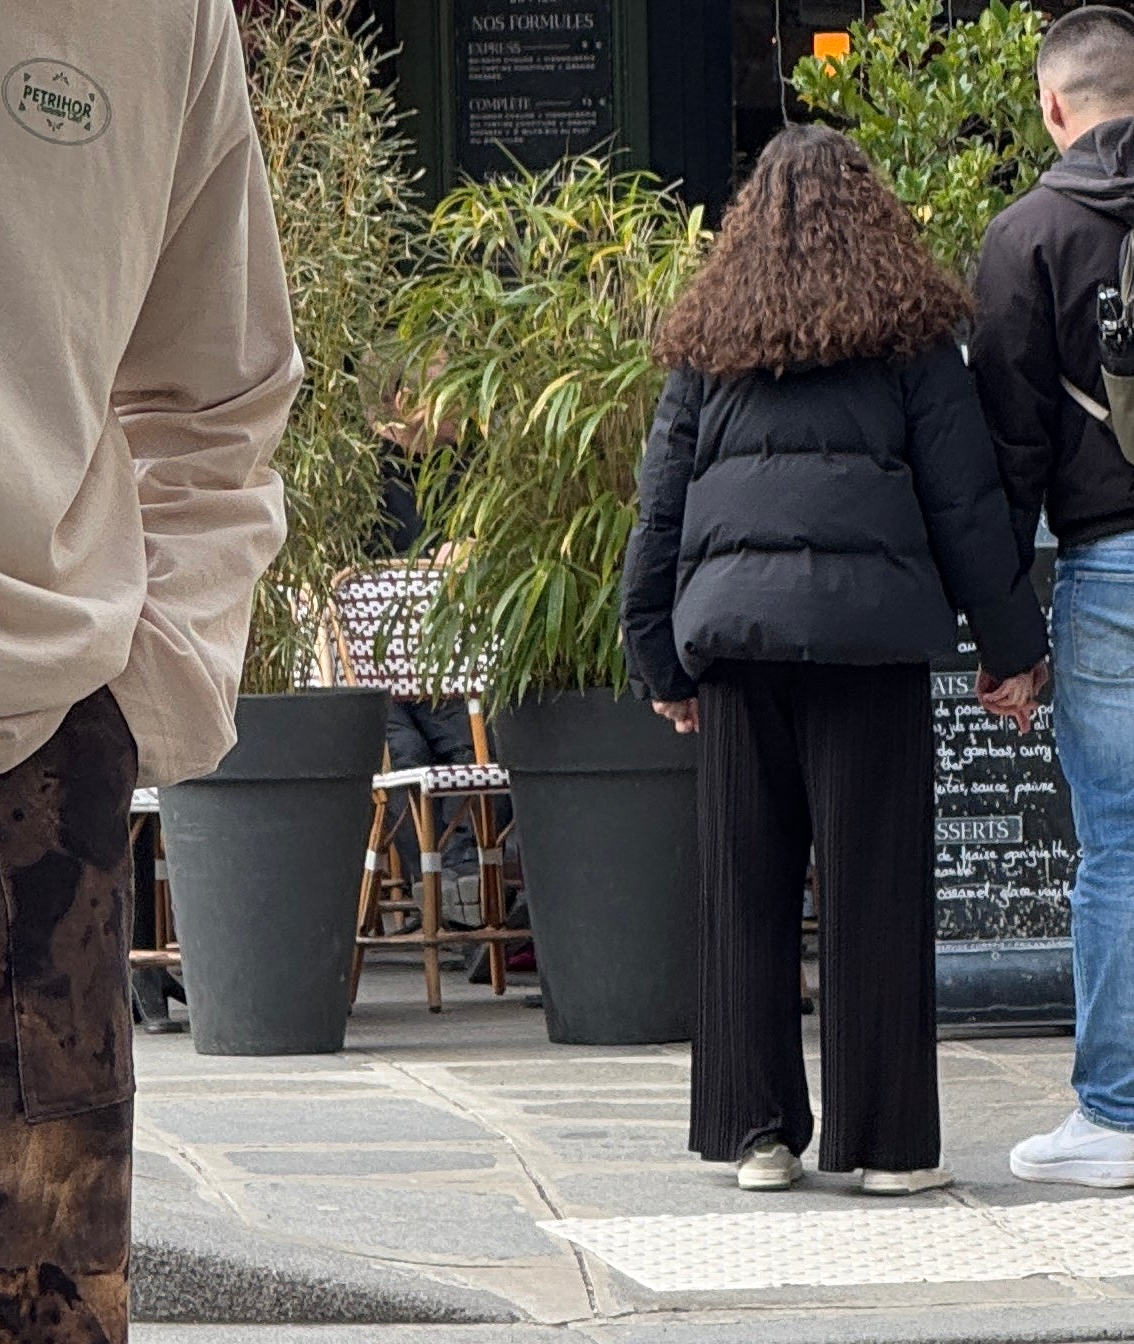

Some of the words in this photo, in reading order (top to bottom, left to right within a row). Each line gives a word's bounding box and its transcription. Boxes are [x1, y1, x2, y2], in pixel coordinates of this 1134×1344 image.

[472, 14, 505, 32] NOS
[509, 13, 594, 31] FORMULES
[23, 84, 92, 119] PETRIHOR
[932, 676, 969, 695] ATS
[971, 782, 1010, 793] sauce
[1014, 781, 1057, 804] poivre
[936, 820, 1009, 841] SSERTS
